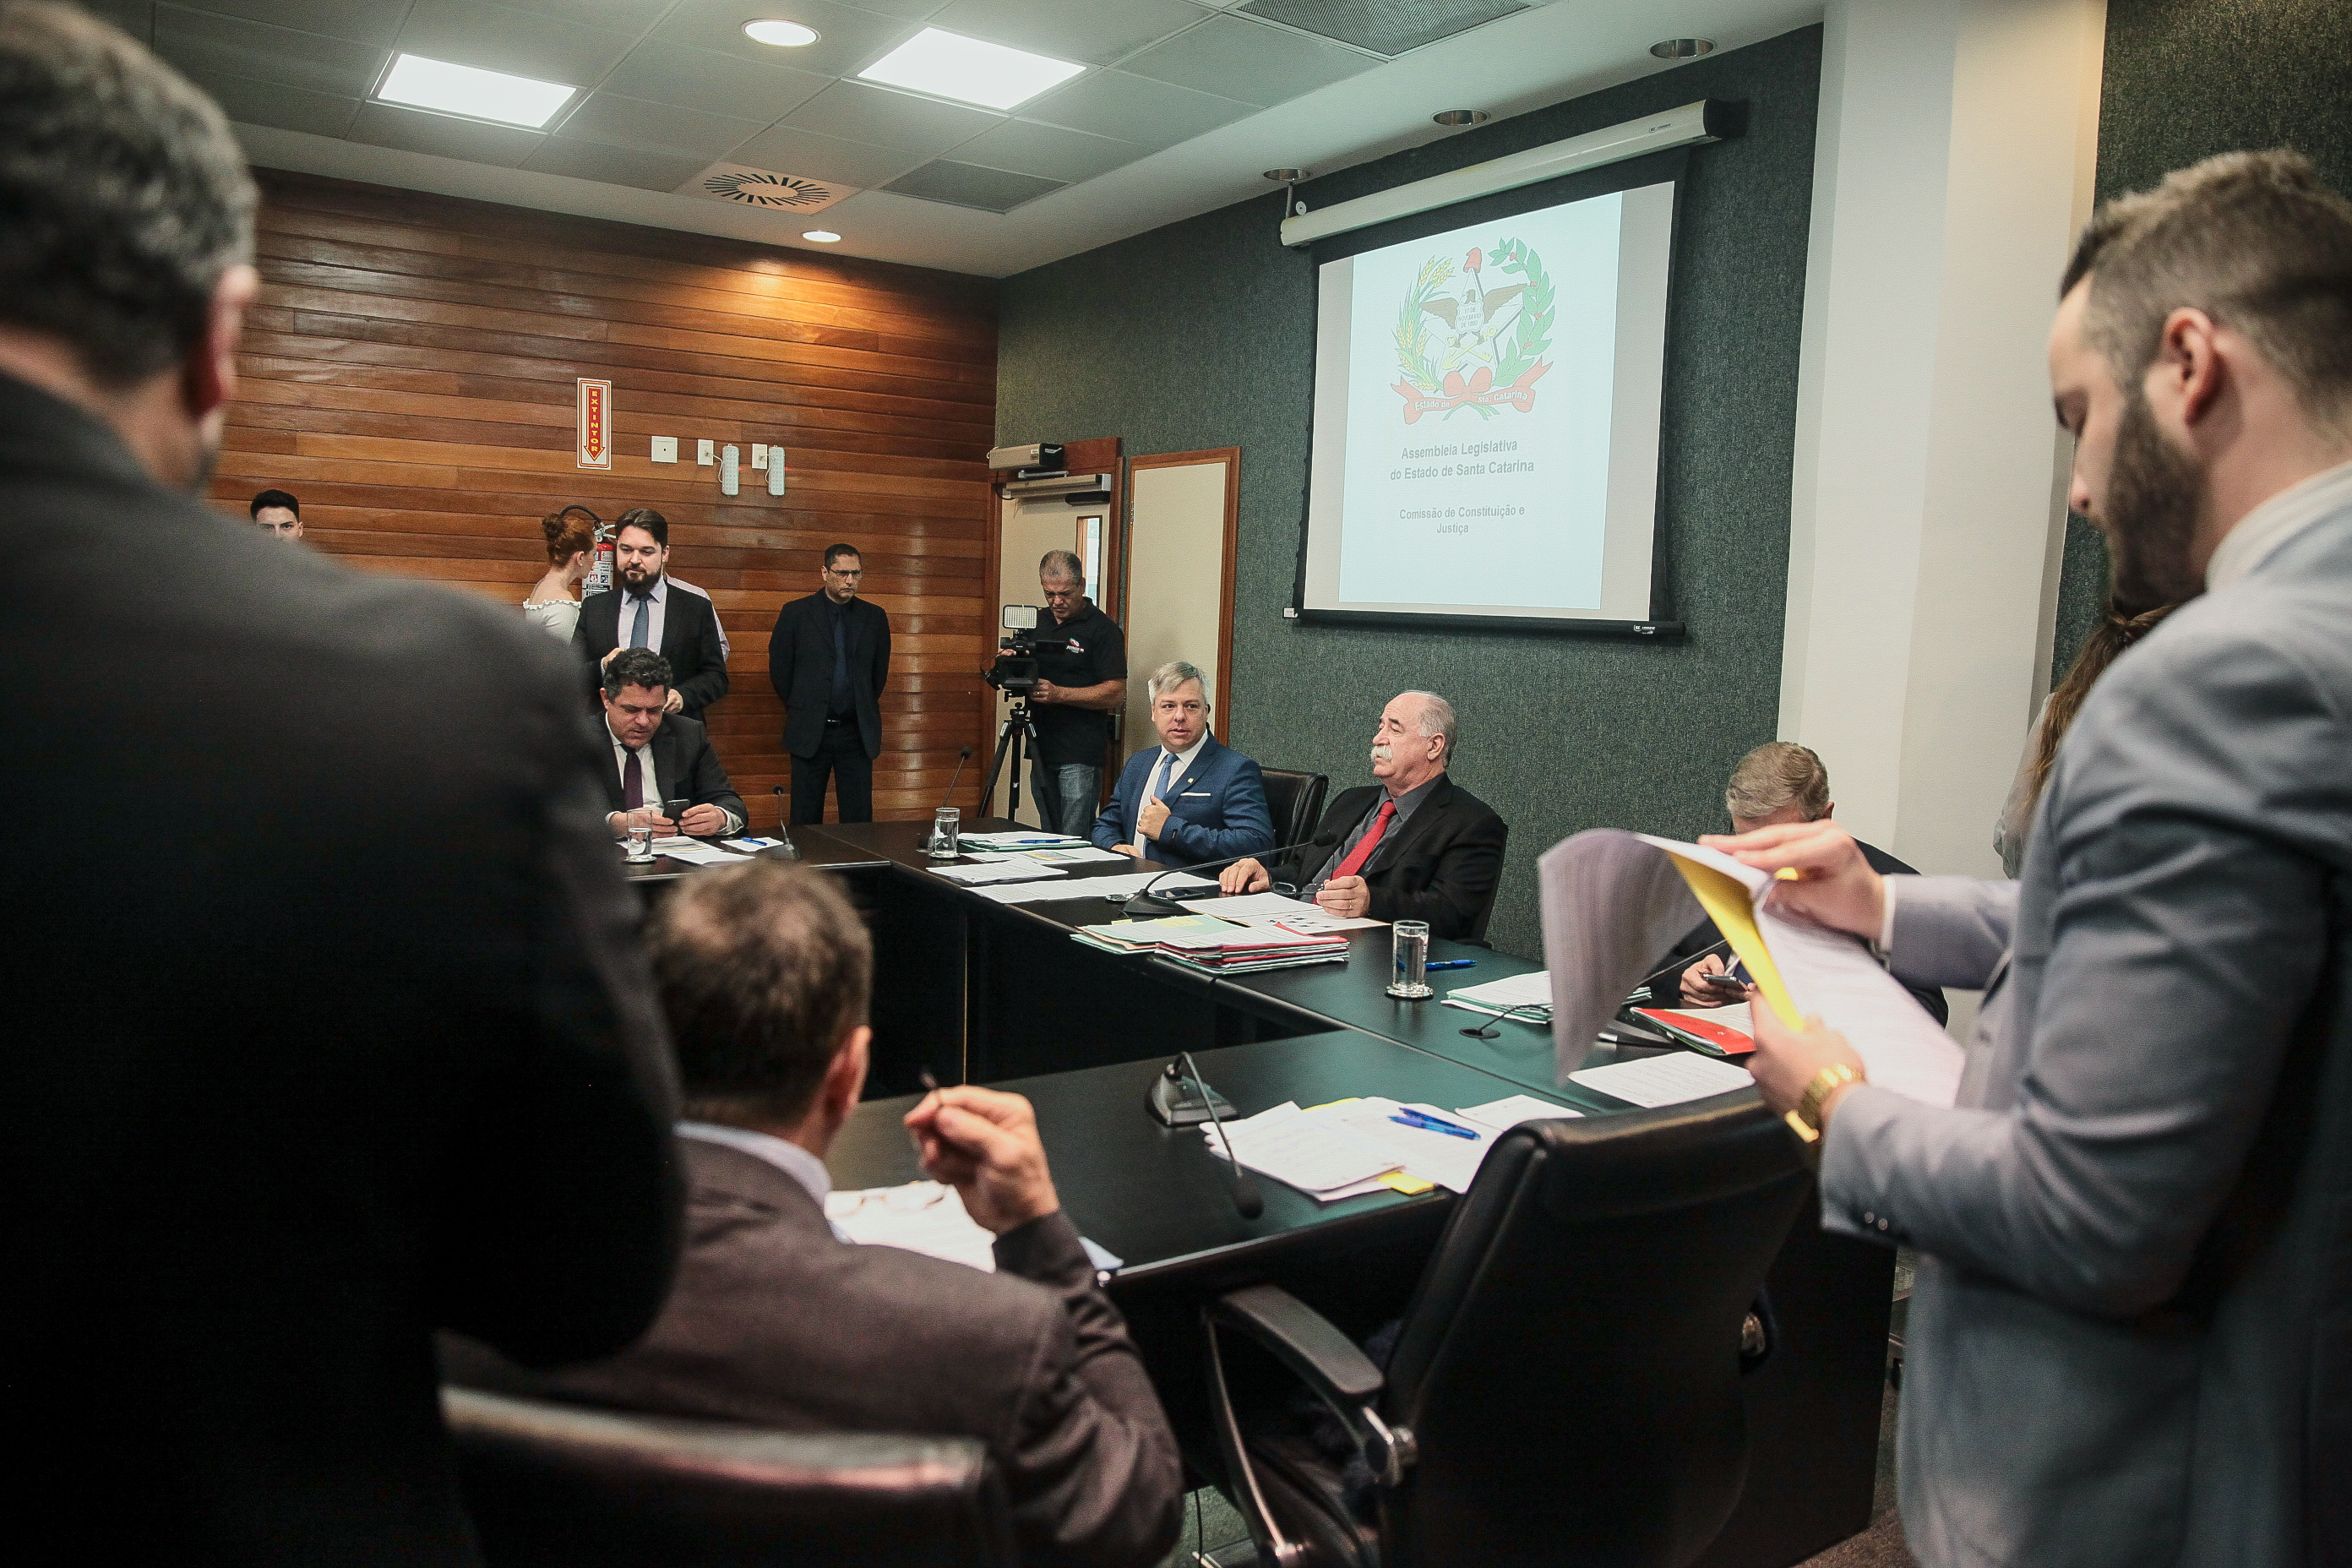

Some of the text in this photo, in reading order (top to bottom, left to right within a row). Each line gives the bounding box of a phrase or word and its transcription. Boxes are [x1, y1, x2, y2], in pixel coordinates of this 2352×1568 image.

[1414, 400, 1440, 411] Estado
[1493, 389, 1528, 402] Catarina
[591, 390, 599, 452] EXTINTOR
[1401, 439, 1517, 460] Assembleia Legislativa
[1390, 459, 1534, 481] do Estado de Santa Catarina
[1399, 504, 1525, 520] Comissão de Constituição e
[1436, 522, 1469, 536] Justiça
